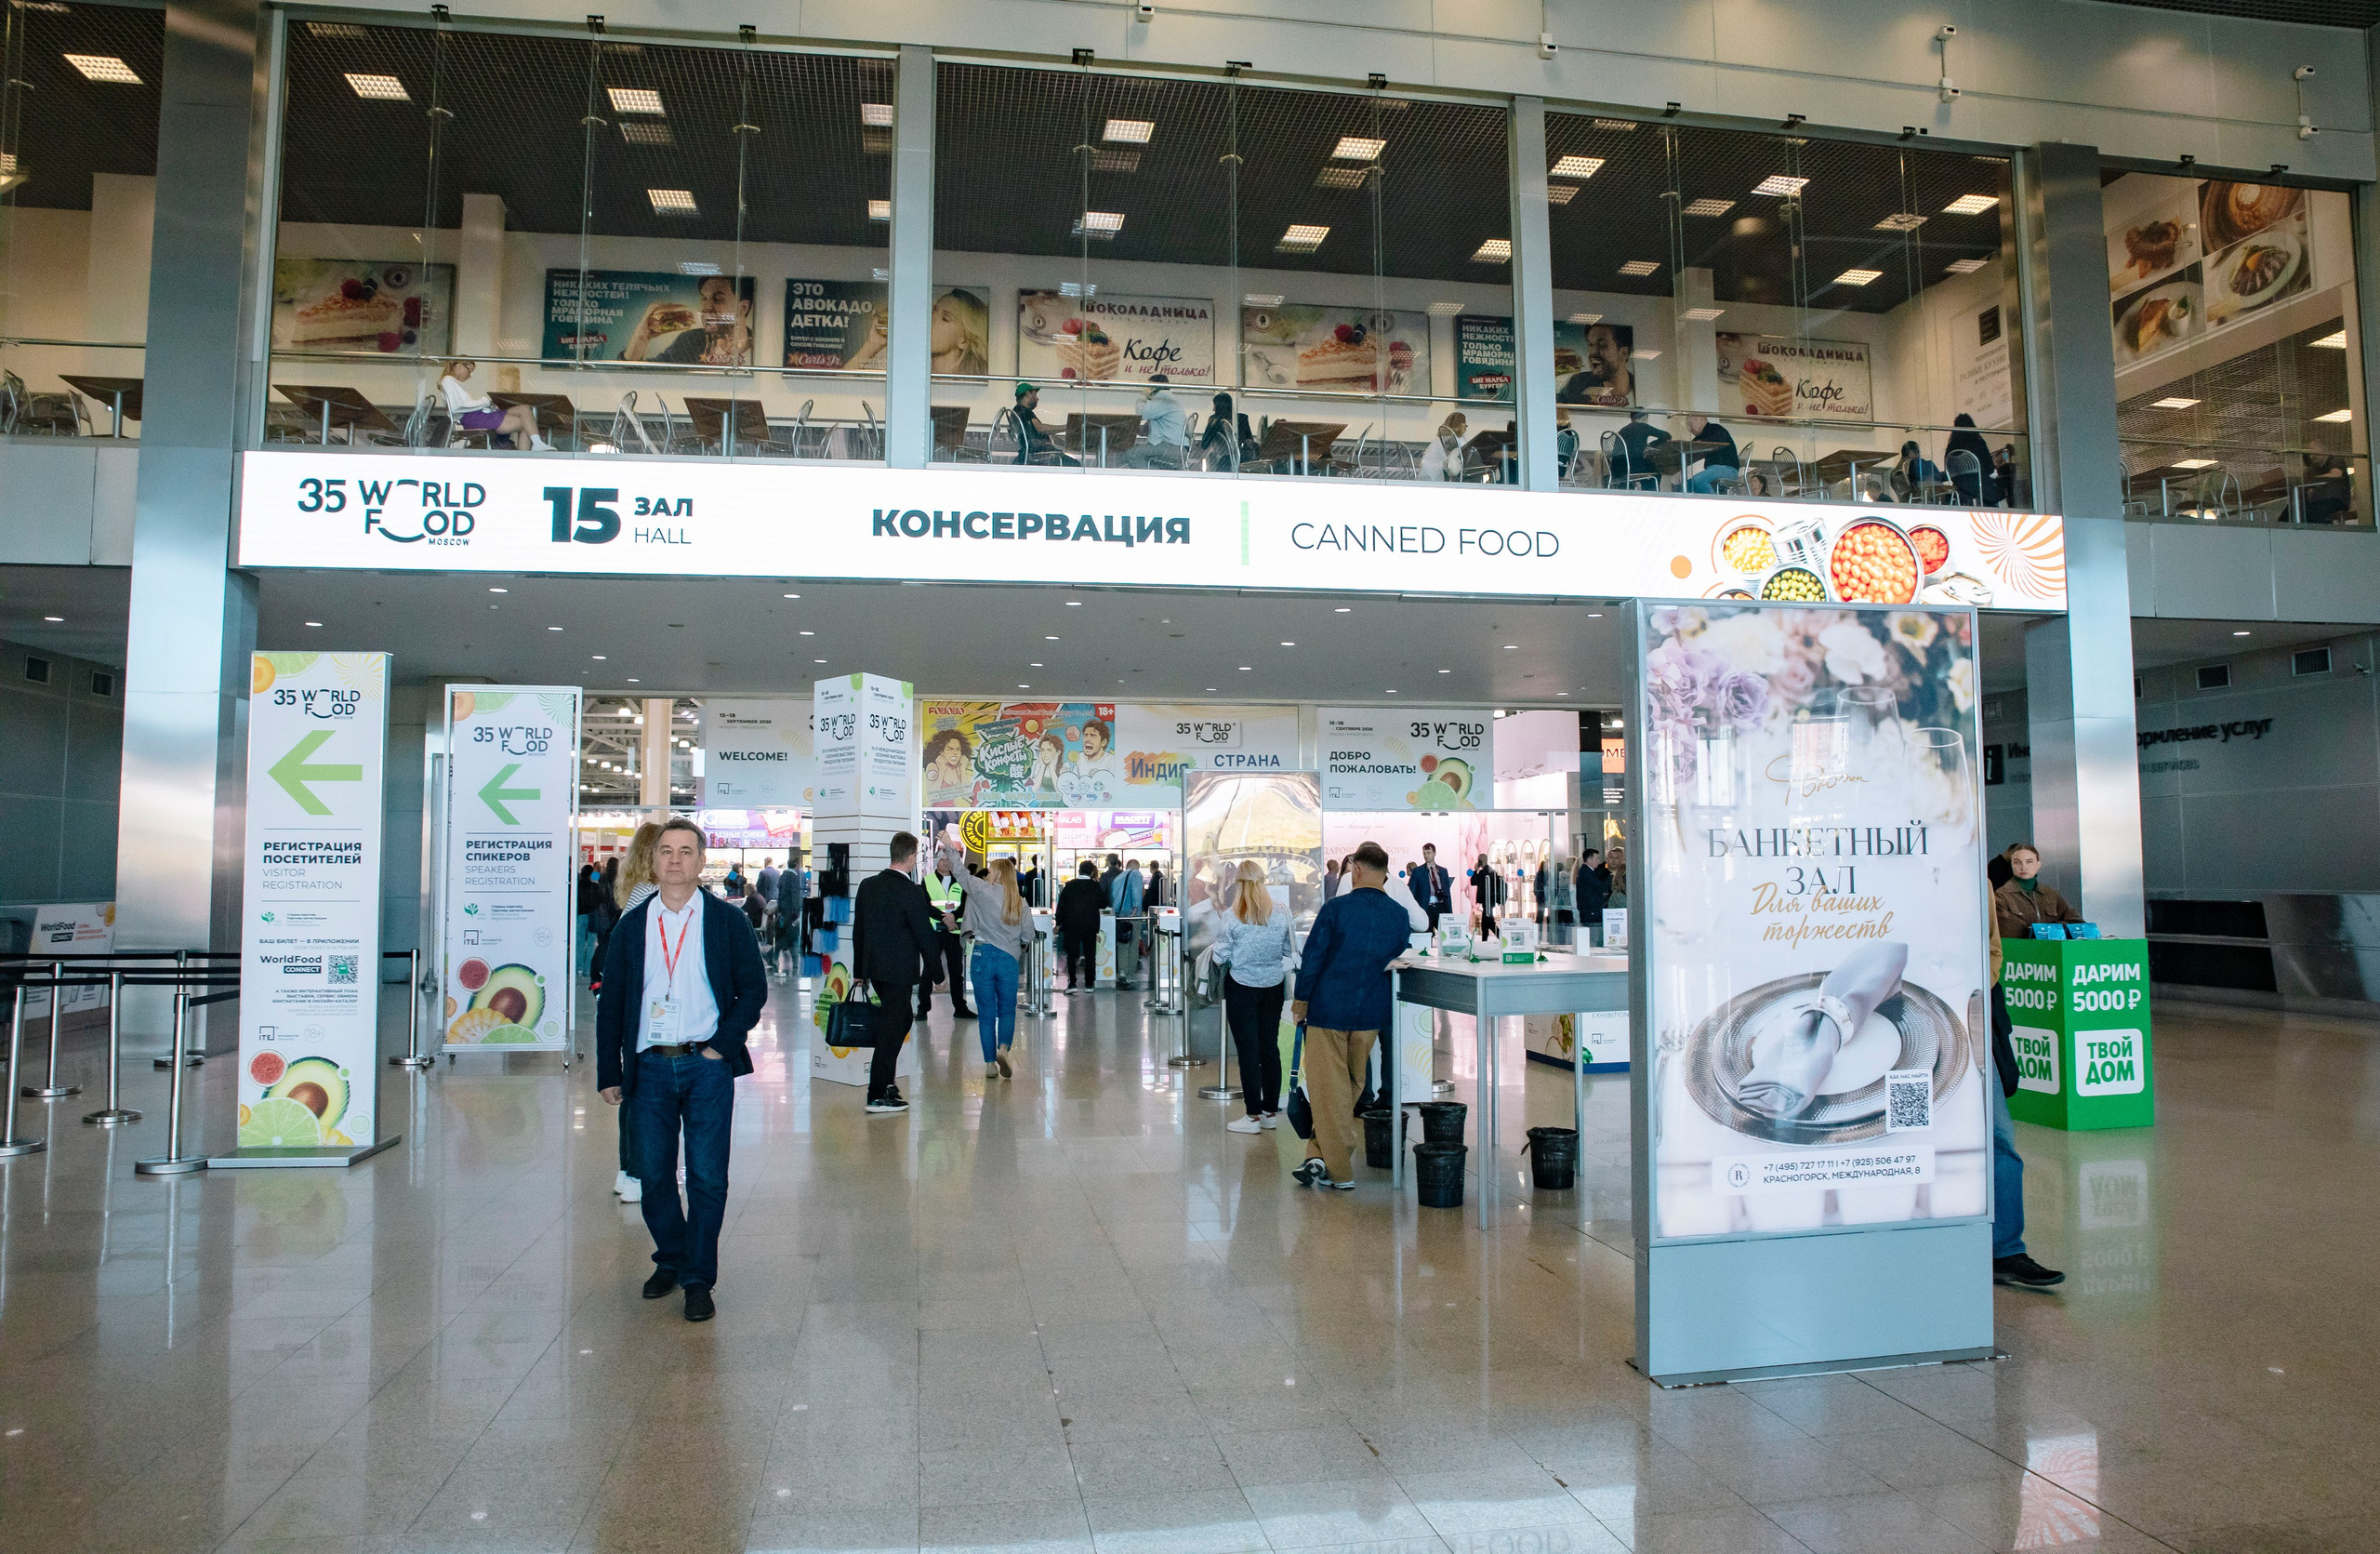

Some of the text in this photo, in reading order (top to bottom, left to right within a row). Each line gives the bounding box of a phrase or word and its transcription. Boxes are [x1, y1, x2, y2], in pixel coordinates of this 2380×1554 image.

[553, 289, 629, 299] НЕЖОСТЕЙ!
[612, 282, 671, 293] ТЕЛЯЧЬИХ
[792, 283, 824, 296] ЭТО
[792, 298, 877, 315] АВОКАДО,
[1079, 299, 1209, 320] ШОКОЛАДНИЦА
[790, 314, 850, 328] ДЕТКА!
[1461, 325, 1509, 335] НИКАКИХ
[1461, 341, 1501, 352] ТОЛЬКО
[1757, 342, 1864, 362] ШОКОЛАДНИЦА
[798, 354, 826, 366] Carl's
[1123, 338, 1183, 372] Кофе
[1462, 356, 1514, 367] ГОВЯДИНА
[1124, 365, 1211, 377] и не только!
[1795, 379, 1844, 409] Кофе
[1826, 403, 1869, 415] только!
[298, 478, 486, 513] 35 WORLD
[633, 497, 694, 517] ЗАЛ
[543, 485, 622, 545] 15
[634, 526, 693, 544] HALL
[871, 507, 1191, 548] КОНСЕРВАЦИЯ
[428, 538, 470, 547] MOSCOW
[1290, 522, 1560, 558] CANNED FOOD
[273, 688, 361, 705] 35 WORLD
[928, 706, 965, 715] FOBOBO
[1098, 706, 1115, 716] 18+
[820, 717, 830, 732] 35
[869, 713, 880, 728] 35
[473, 726, 553, 743] 35 WORLD
[1176, 722, 1232, 735] 35 WORLD
[1410, 722, 1485, 737] 35 WORLD
[2136, 717, 2274, 750] ормление услуг
[719, 751, 788, 762] WELCOME!
[1214, 754, 1281, 767] СТРАНА
[1329, 751, 1371, 762] ДОБРО
[1130, 758, 1189, 782] Индия
[1329, 764, 1417, 774] ПОЖАЛОВАТЬ!
[966, 821, 983, 846] САХАРА
[1708, 819, 1929, 858] БАНКЕТНЫЙ
[263, 842, 362, 854] РЕГИСТРАЦИЯ
[466, 840, 552, 850] РЕГИСТРАЦИЯ
[262, 852, 362, 864] ПОСЕТИТЕЛЕЙ
[465, 853, 531, 861] СПИКЕРОВ
[262, 868, 306, 877] VISITOR
[465, 865, 517, 874] SPEAKERS
[261, 881, 343, 890] REGISTRATION
[465, 877, 536, 885] REGISTRATION
[1786, 865, 1858, 896] ЗАЛ
[1751, 882, 1885, 916] Для ваших
[40, 921, 76, 932] WorldFood
[1762, 911, 1894, 950] торжеств
[259, 955, 323, 963] WorldFood
[2004, 962, 2056, 983] ДАРИМ
[2072, 963, 2141, 986] ДАРИМ
[2004, 987, 2044, 1010] 5000
[2072, 990, 2125, 1013] 5000
[2015, 1035, 2051, 1058] ТВОЙ
[2086, 1035, 2133, 1059] ТВОЙ
[2016, 1056, 2053, 1082] ДОМ
[2085, 1059, 2135, 1085] ДОМ
[1775, 1162, 1798, 1173] (495)
[1800, 1162, 1815, 1170] 727
[1817, 1161, 1825, 1169] 17
[1841, 1159, 1851, 1167] +7
[1852, 1157, 1874, 1168] (925)
[1875, 1156, 1892, 1164] 506
[1735, 1169, 1743, 1181] R
[1763, 1172, 1831, 1184] КРАСНОГОРСК,
[1831, 1167, 1914, 1180] МЕЖДУНАРОДНАЯ,
[1914, 1166, 1921, 1175] 8
